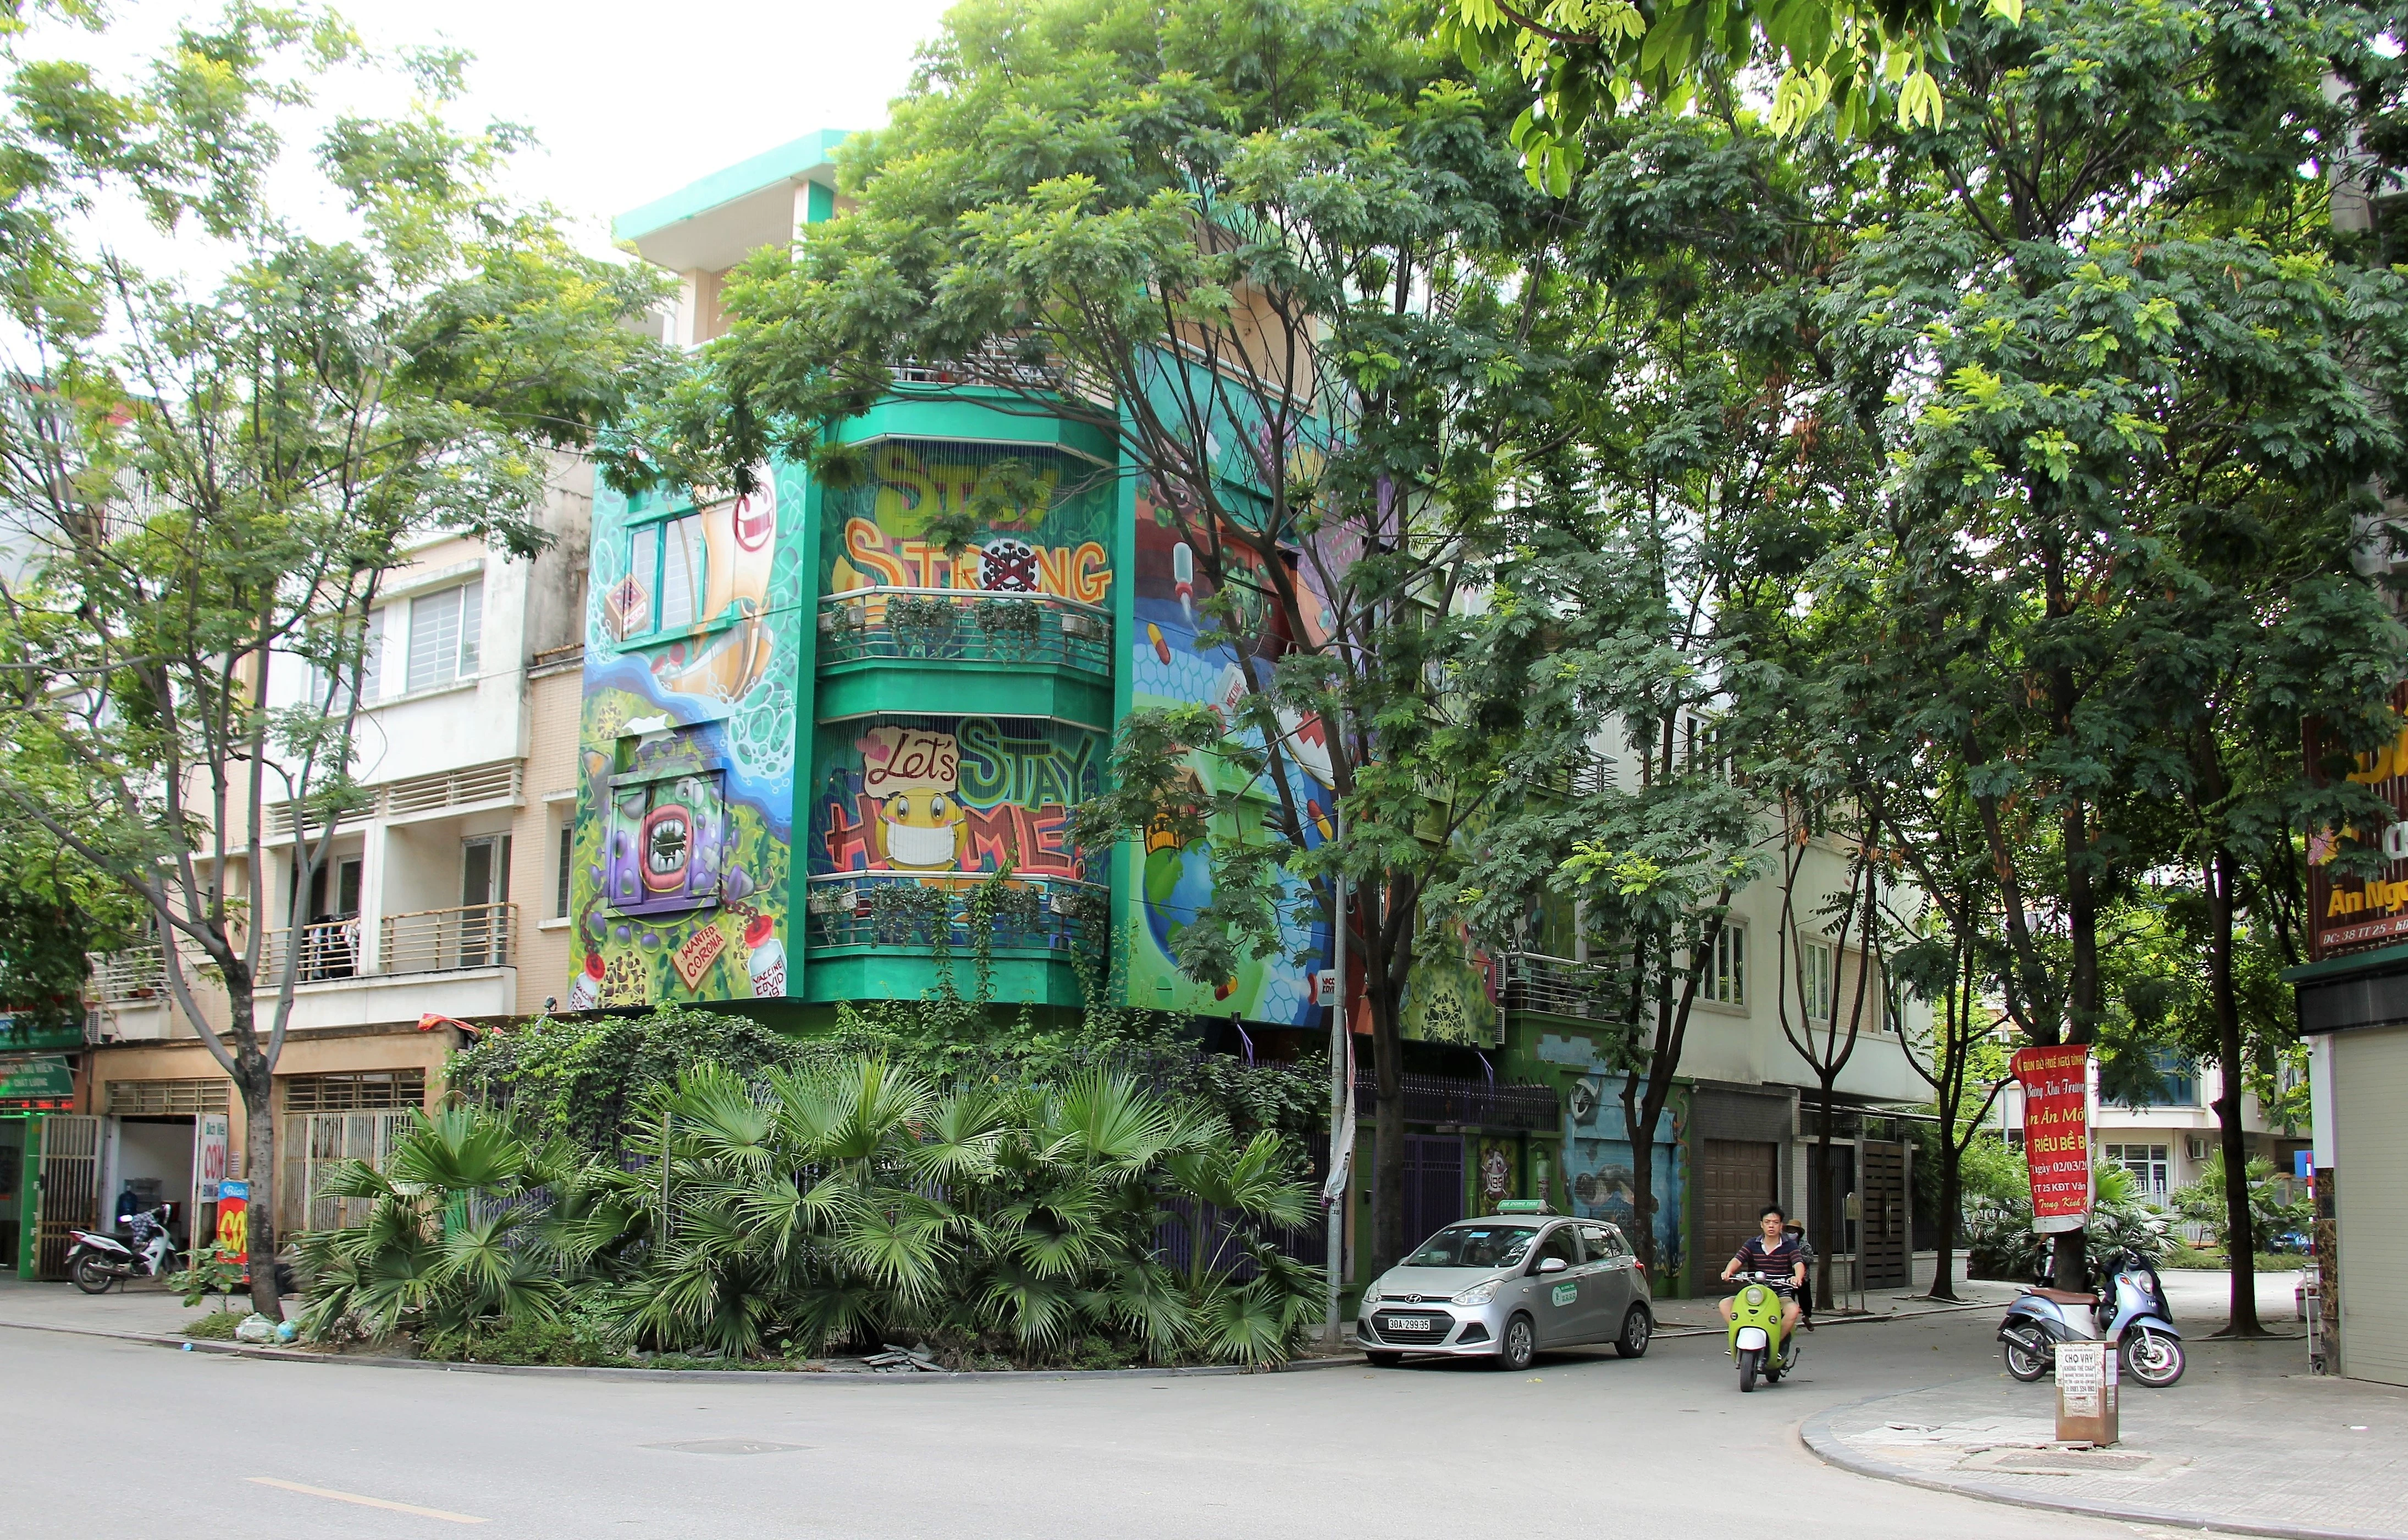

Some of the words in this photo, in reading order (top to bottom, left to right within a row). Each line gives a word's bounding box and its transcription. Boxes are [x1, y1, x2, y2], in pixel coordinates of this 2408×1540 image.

[869, 733, 955, 785] Let's
[957, 717, 1095, 812] STAY
[2327, 884, 2363, 917] Ăn
[2342, 929, 2355, 940] 38
[2357, 926, 2371, 938] TT
[2372, 924, 2386, 935] 25
[687, 935, 723, 977] CORONA
[753, 960, 782, 984] VACCINE
[756, 973, 783, 996] COVID
[2045, 1080, 2060, 1096] Khai
[2041, 1106, 2058, 1124] Ăn
[2034, 1134, 2058, 1152] RIÊU
[2060, 1130, 2076, 1151] BỀ
[1488, 1175, 1503, 1189] N95
[2043, 1184, 2050, 1192] 25
[2052, 1183, 2069, 1192] KĐT
[2072, 1182, 2086, 1190] Văn
[2080, 1353, 2093, 1363] VAY
